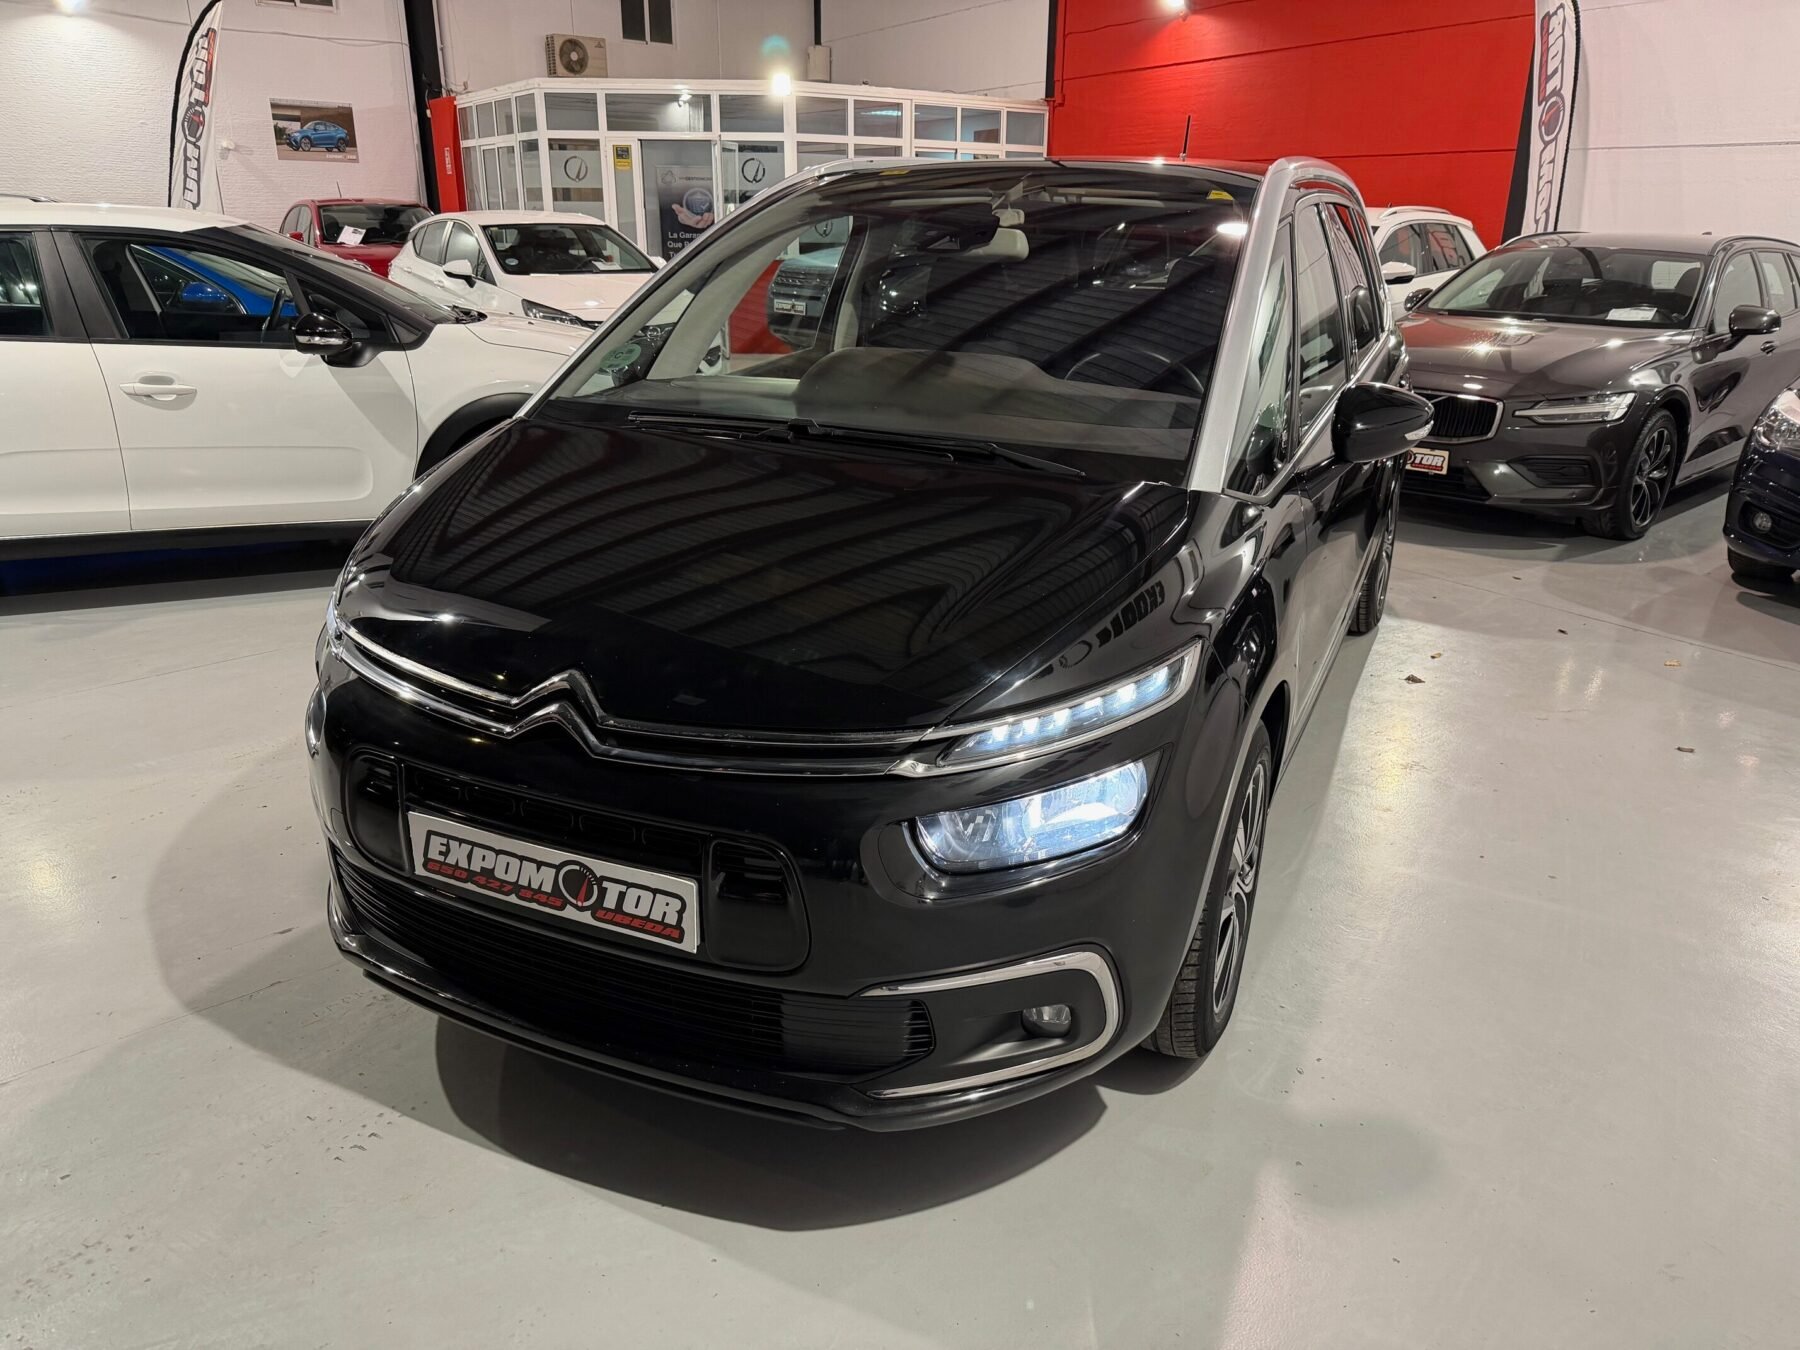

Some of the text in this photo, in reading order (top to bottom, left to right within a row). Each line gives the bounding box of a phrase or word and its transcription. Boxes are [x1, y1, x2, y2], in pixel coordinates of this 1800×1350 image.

[668, 231, 678, 239] La
[427, 834, 682, 926] EXPOMOTOR
[427, 861, 468, 880] 650
[473, 875, 513, 892] 427
[595, 909, 680, 939] UBEDA
